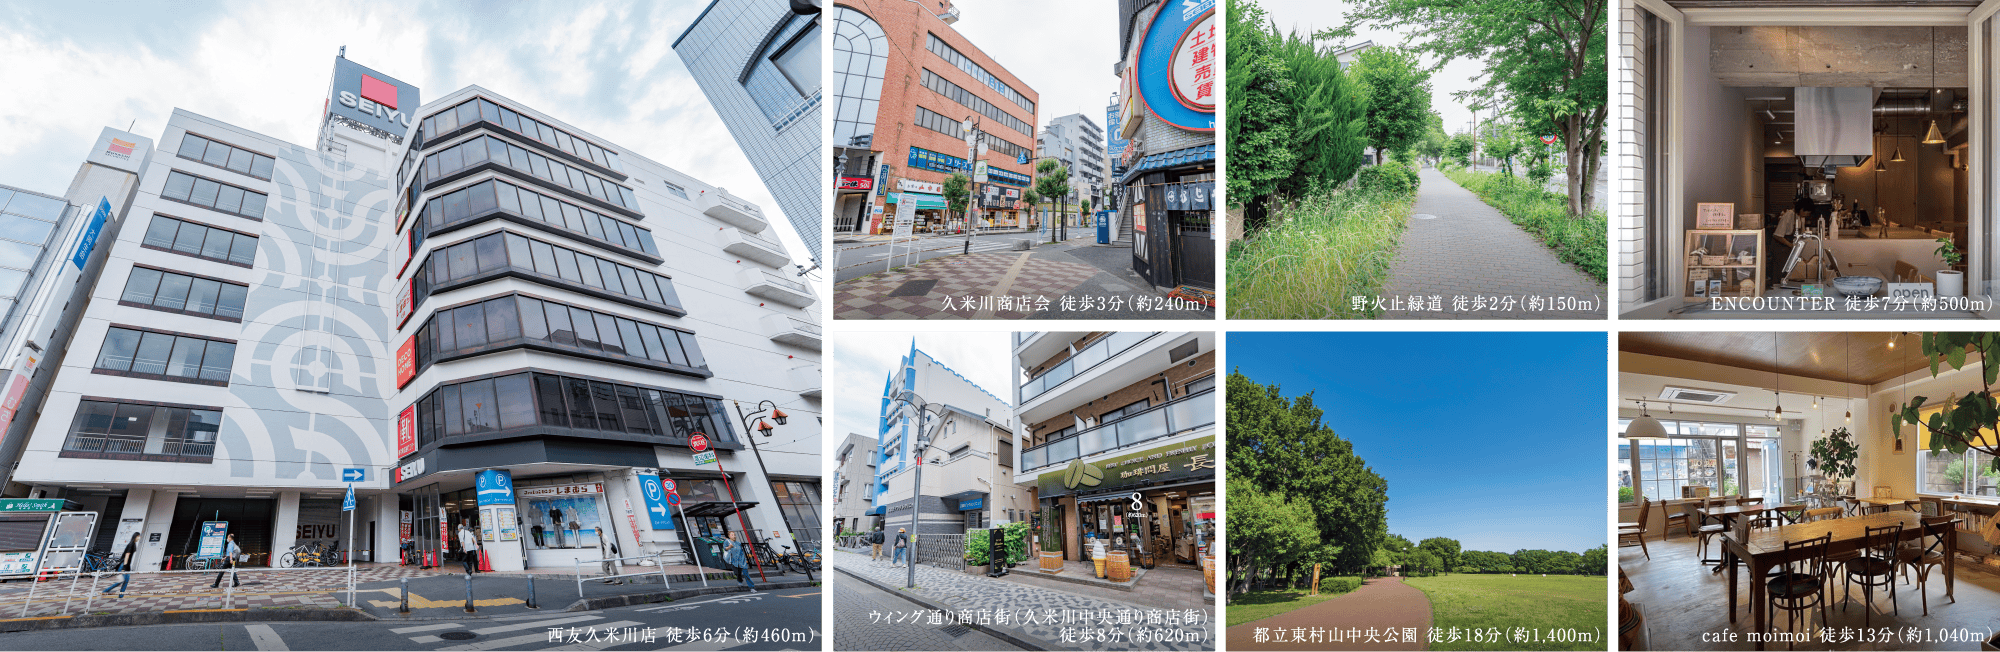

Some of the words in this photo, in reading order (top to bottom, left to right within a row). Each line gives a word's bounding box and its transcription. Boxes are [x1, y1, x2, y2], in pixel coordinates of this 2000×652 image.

[1194, 62, 1216, 83] 売
[339, 90, 410, 129] SEIYU
[1893, 287, 1929, 300] open
[1146, 453, 1163, 461] AND
[296, 524, 336, 539] SEIYU
